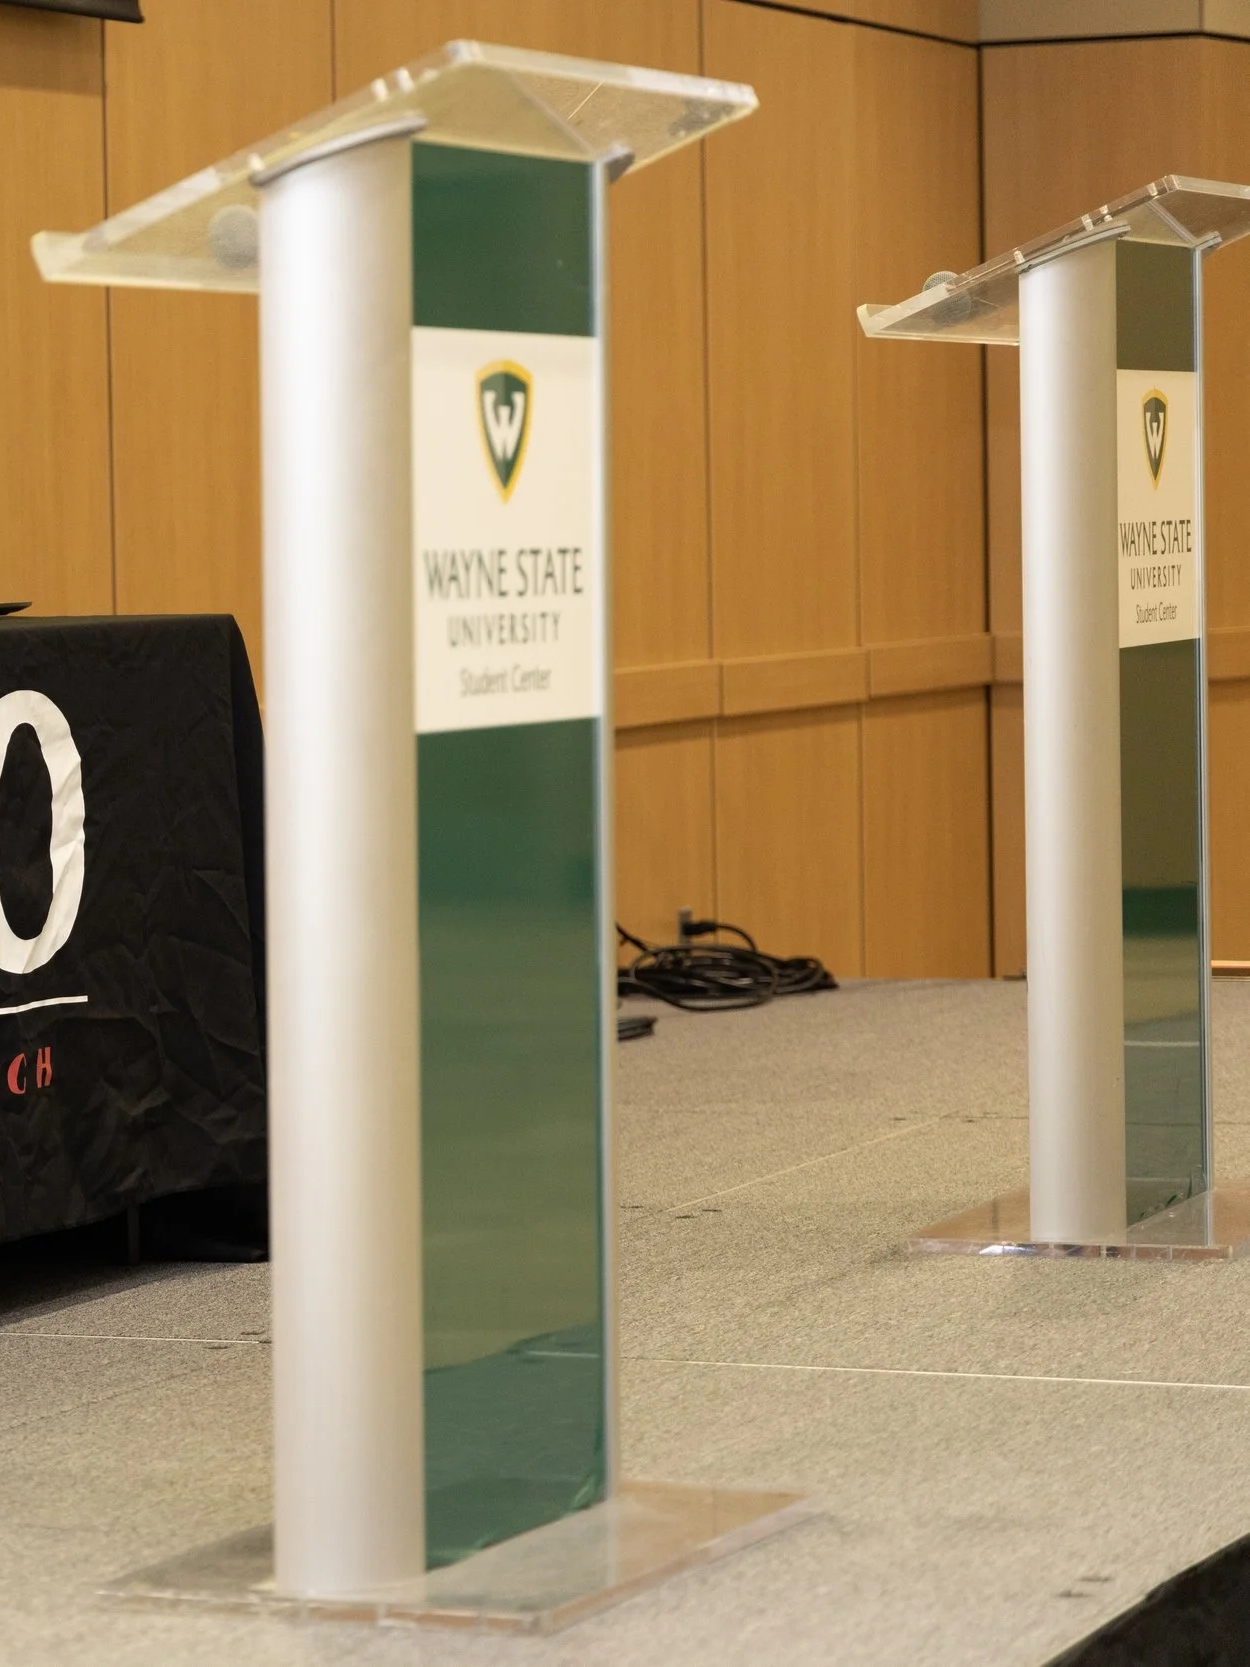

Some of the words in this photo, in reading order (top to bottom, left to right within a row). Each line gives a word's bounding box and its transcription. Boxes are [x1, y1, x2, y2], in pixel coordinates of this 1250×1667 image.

[1119, 521, 1157, 557] WAYNE
[1161, 519, 1192, 555] STATE
[423, 548, 508, 600] WAYNE
[516, 547, 583, 597] STATE
[1130, 564, 1182, 590] UNIVERSITY
[1136, 603, 1158, 624] Student
[1159, 601, 1178, 621] Center
[446, 612, 562, 649] UNIVERSITY
[460, 665, 508, 697] Student
[511, 663, 552, 693] Center
